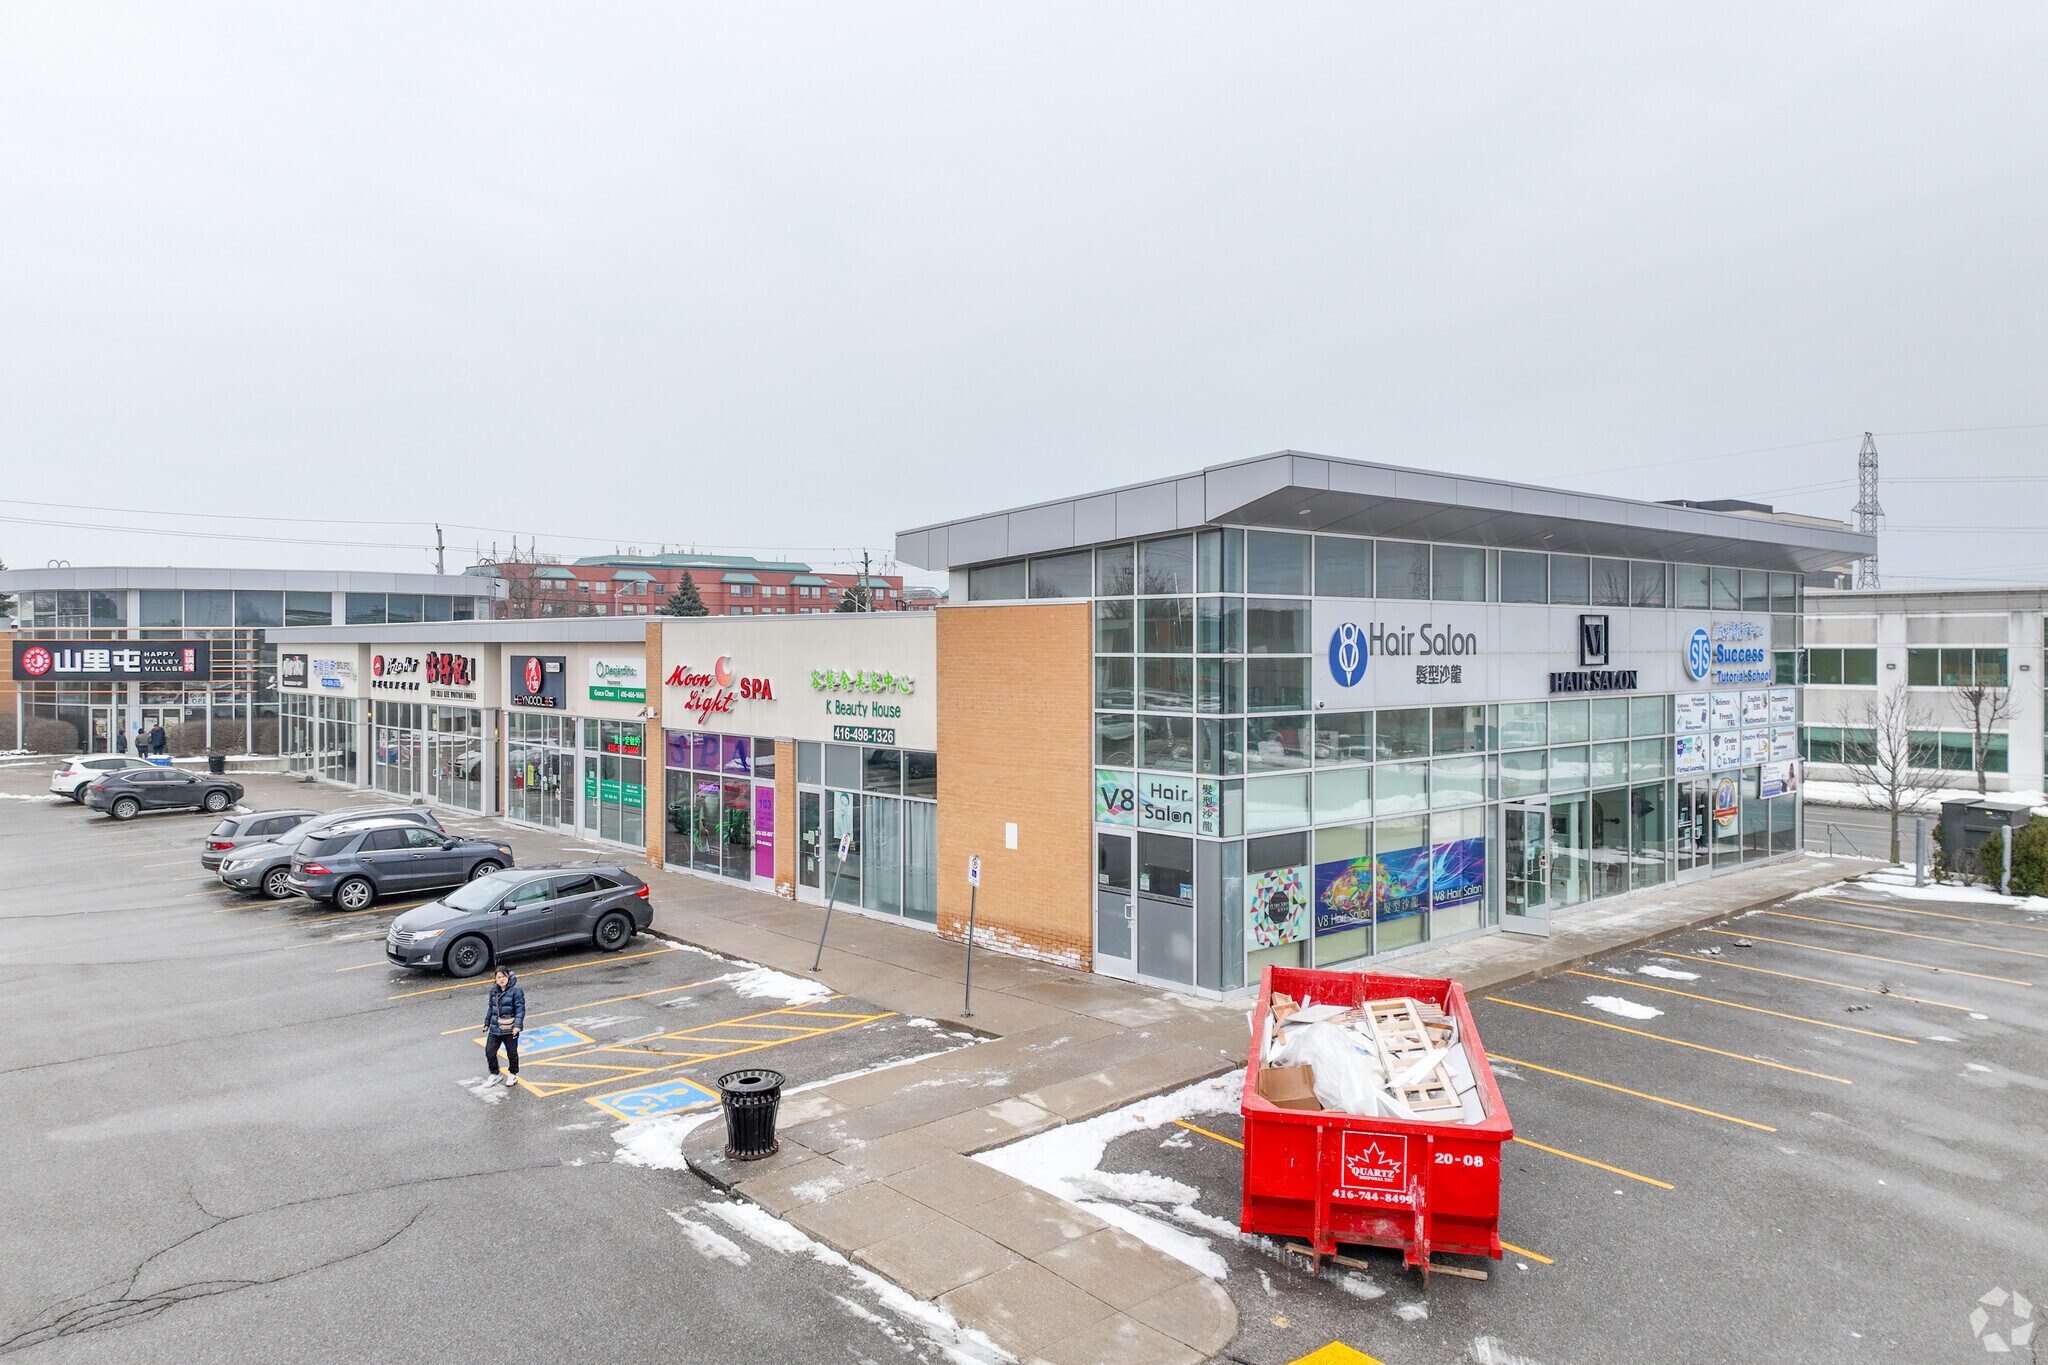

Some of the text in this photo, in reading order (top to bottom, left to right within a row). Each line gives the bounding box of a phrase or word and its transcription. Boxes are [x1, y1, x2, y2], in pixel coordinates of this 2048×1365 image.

[1369, 622, 1477, 656] Hair Salon
[54, 648, 142, 673] 山里屯
[1716, 643, 1764, 664] Success
[604, 664, 637, 678] Desjardins
[664, 665, 713, 687] Moon
[1416, 664, 1462, 685] 髮型沙龍
[1716, 668, 1772, 684] Tutorial School
[740, 677, 773, 701] SPA
[1553, 670, 1638, 693] HAIR SALON
[684, 689, 734, 725] Light
[1747, 695, 1761, 703] English
[1770, 695, 1789, 703] Chemistry
[825, 699, 902, 719] K Beauty House
[1719, 712, 1734, 720] French
[1782, 705, 1795, 713] Biology
[1744, 717, 1767, 725] Mathematics
[834, 726, 895, 744] 416-498-1326
[1101, 786, 1135, 812] V8
[1150, 783, 1189, 802] Hair
[759, 799, 772, 809] 103
[1202, 784, 1214, 833] 髮型沙龍
[1145, 804, 1193, 825] Salon
[1434, 884, 1482, 902] V8 Hair Salon
[1317, 908, 1370, 927] V8 Hair Salon
[1434, 1152, 1484, 1168] 20-08
[1351, 1166, 1395, 1179] QUARTZ
[1332, 1188, 1413, 1205] 416-744-8499
